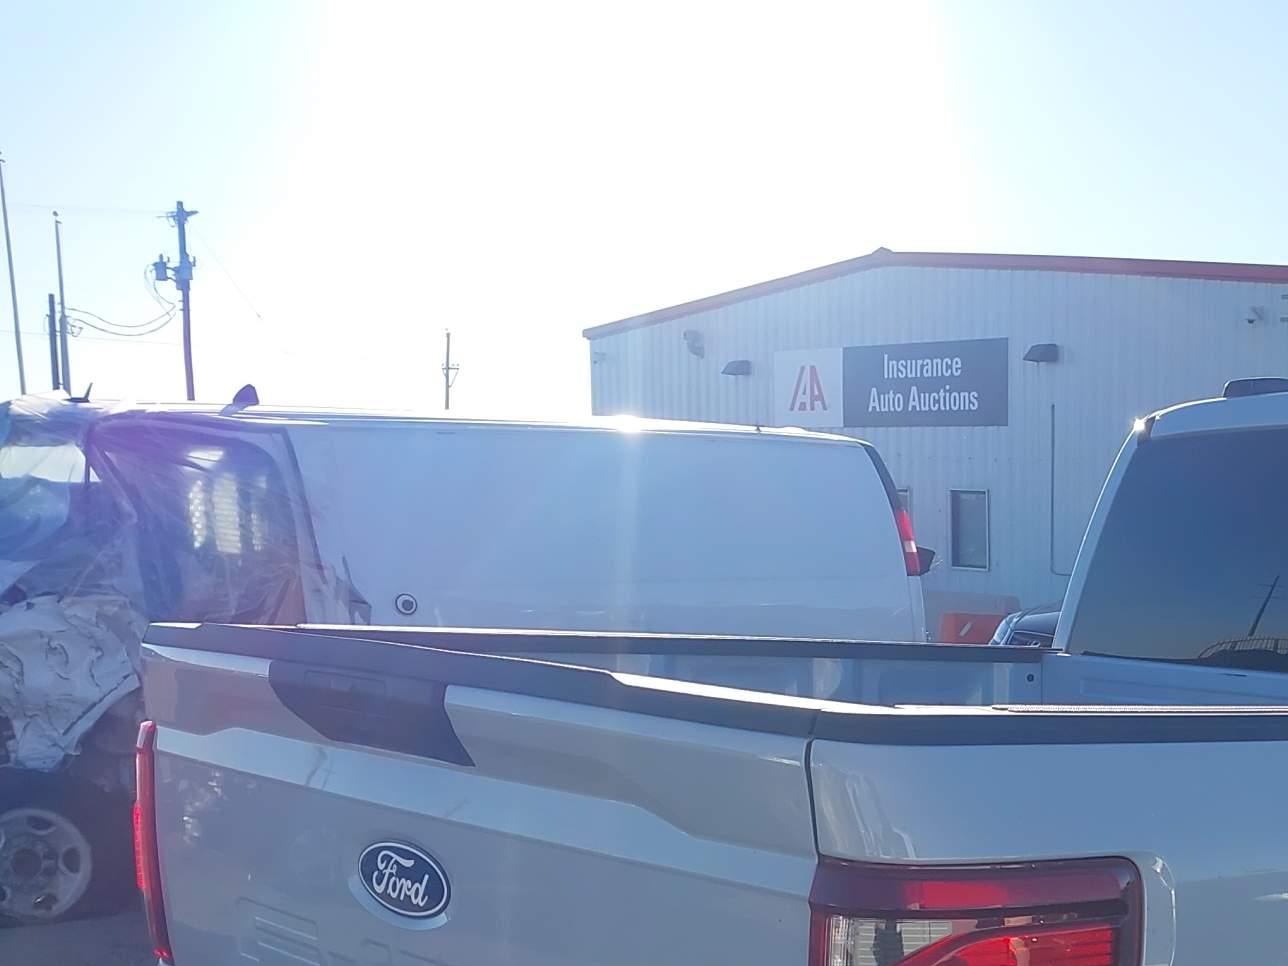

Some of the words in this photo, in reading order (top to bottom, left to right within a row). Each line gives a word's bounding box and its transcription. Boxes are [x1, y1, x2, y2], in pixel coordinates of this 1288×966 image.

[883, 354, 962, 379] Insurance
[868, 387, 904, 412] Auto
[908, 385, 979, 412] Auctions
[372, 850, 429, 907] Ford
